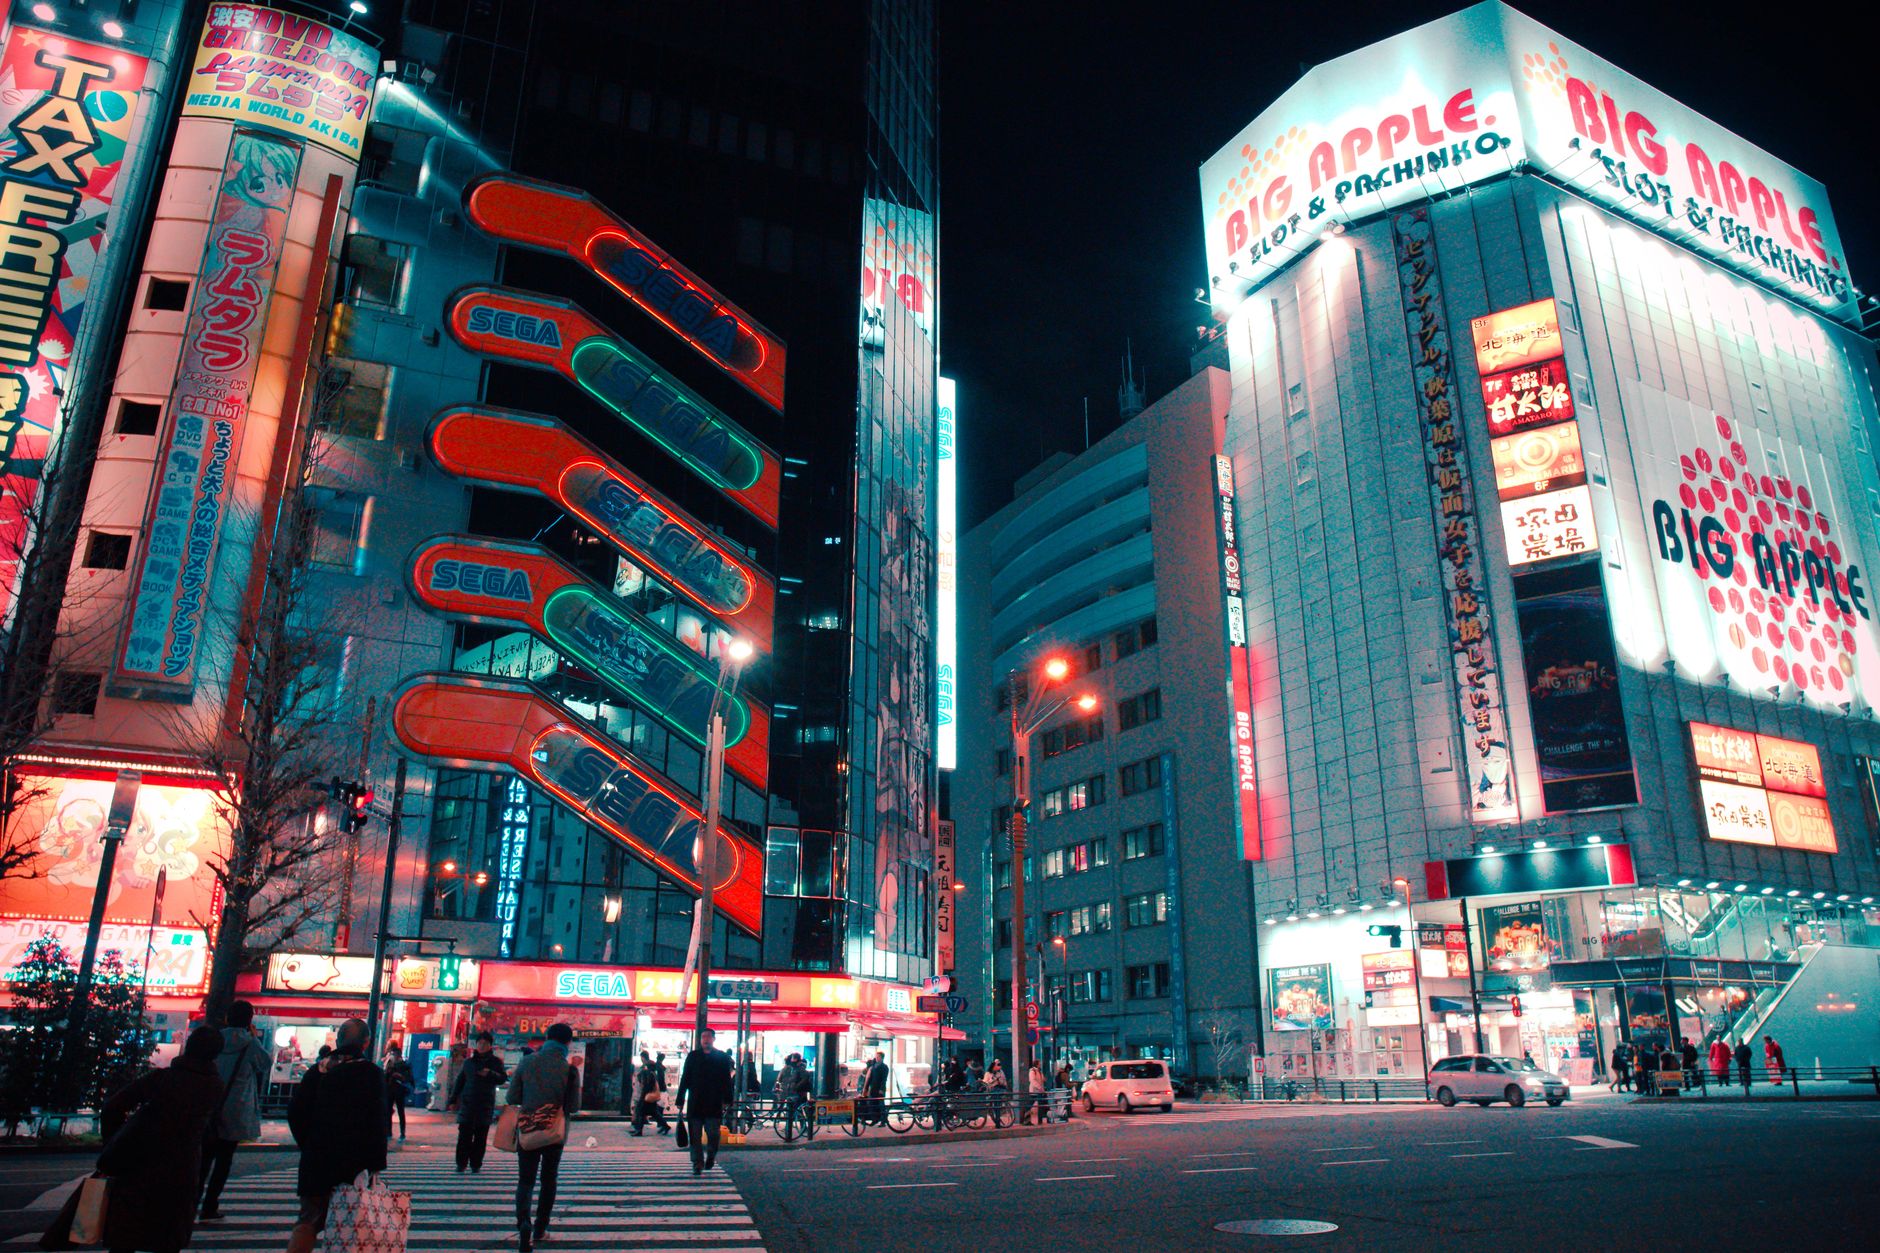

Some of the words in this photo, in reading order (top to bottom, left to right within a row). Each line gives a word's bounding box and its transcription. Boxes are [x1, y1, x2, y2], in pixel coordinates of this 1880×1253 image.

[254, 8, 333, 49] DVD
[215, 70, 344, 121] ラムタラ
[7, 53, 112, 186] TAX
[187, 93, 241, 109] MEDIA
[248, 100, 305, 124] WORLD
[308, 119, 359, 149] AKIBA
[1566, 77, 1668, 176] BIG
[1226, 175, 1293, 256] BIG
[1308, 196, 1326, 220] &
[196, 230, 268, 369] ラムタラ
[609, 248, 738, 357] SEGA
[468, 305, 561, 348] SEGA
[1481, 326, 1551, 352] 北海道
[199, 386, 226, 398] アキバ
[1485, 380, 1502, 392] 7F
[1487, 383, 1569, 423] 甘太郎
[177, 431, 201, 441] DVD
[600, 360, 730, 474] SEGA
[939, 406, 953, 460] SEGA
[1513, 411, 1552, 426] AMATARO
[1534, 480, 1550, 491] 6F
[1543, 463, 1577, 478] MARU
[158, 507, 189, 519] GAME
[583, 477, 723, 586] SEGA
[150, 544, 181, 557] GAME
[152, 536, 170, 546] PC
[1653, 499, 1734, 579] BIG
[1752, 532, 1870, 621] APPLE
[141, 581, 172, 593] BOOK
[430, 559, 532, 602] SEGA
[128, 658, 153, 670] トレカ
[568, 612, 711, 738] SEGA
[939, 664, 953, 726] SEGA
[1237, 711, 1250, 739] BIG
[1239, 745, 1253, 790] APPLE
[1766, 758, 1816, 784] 北海道
[557, 747, 703, 876] SEGA
[101, 927, 165, 944] GAME
[556, 971, 631, 999] SEGA
[949, 998, 959, 1009] 17
